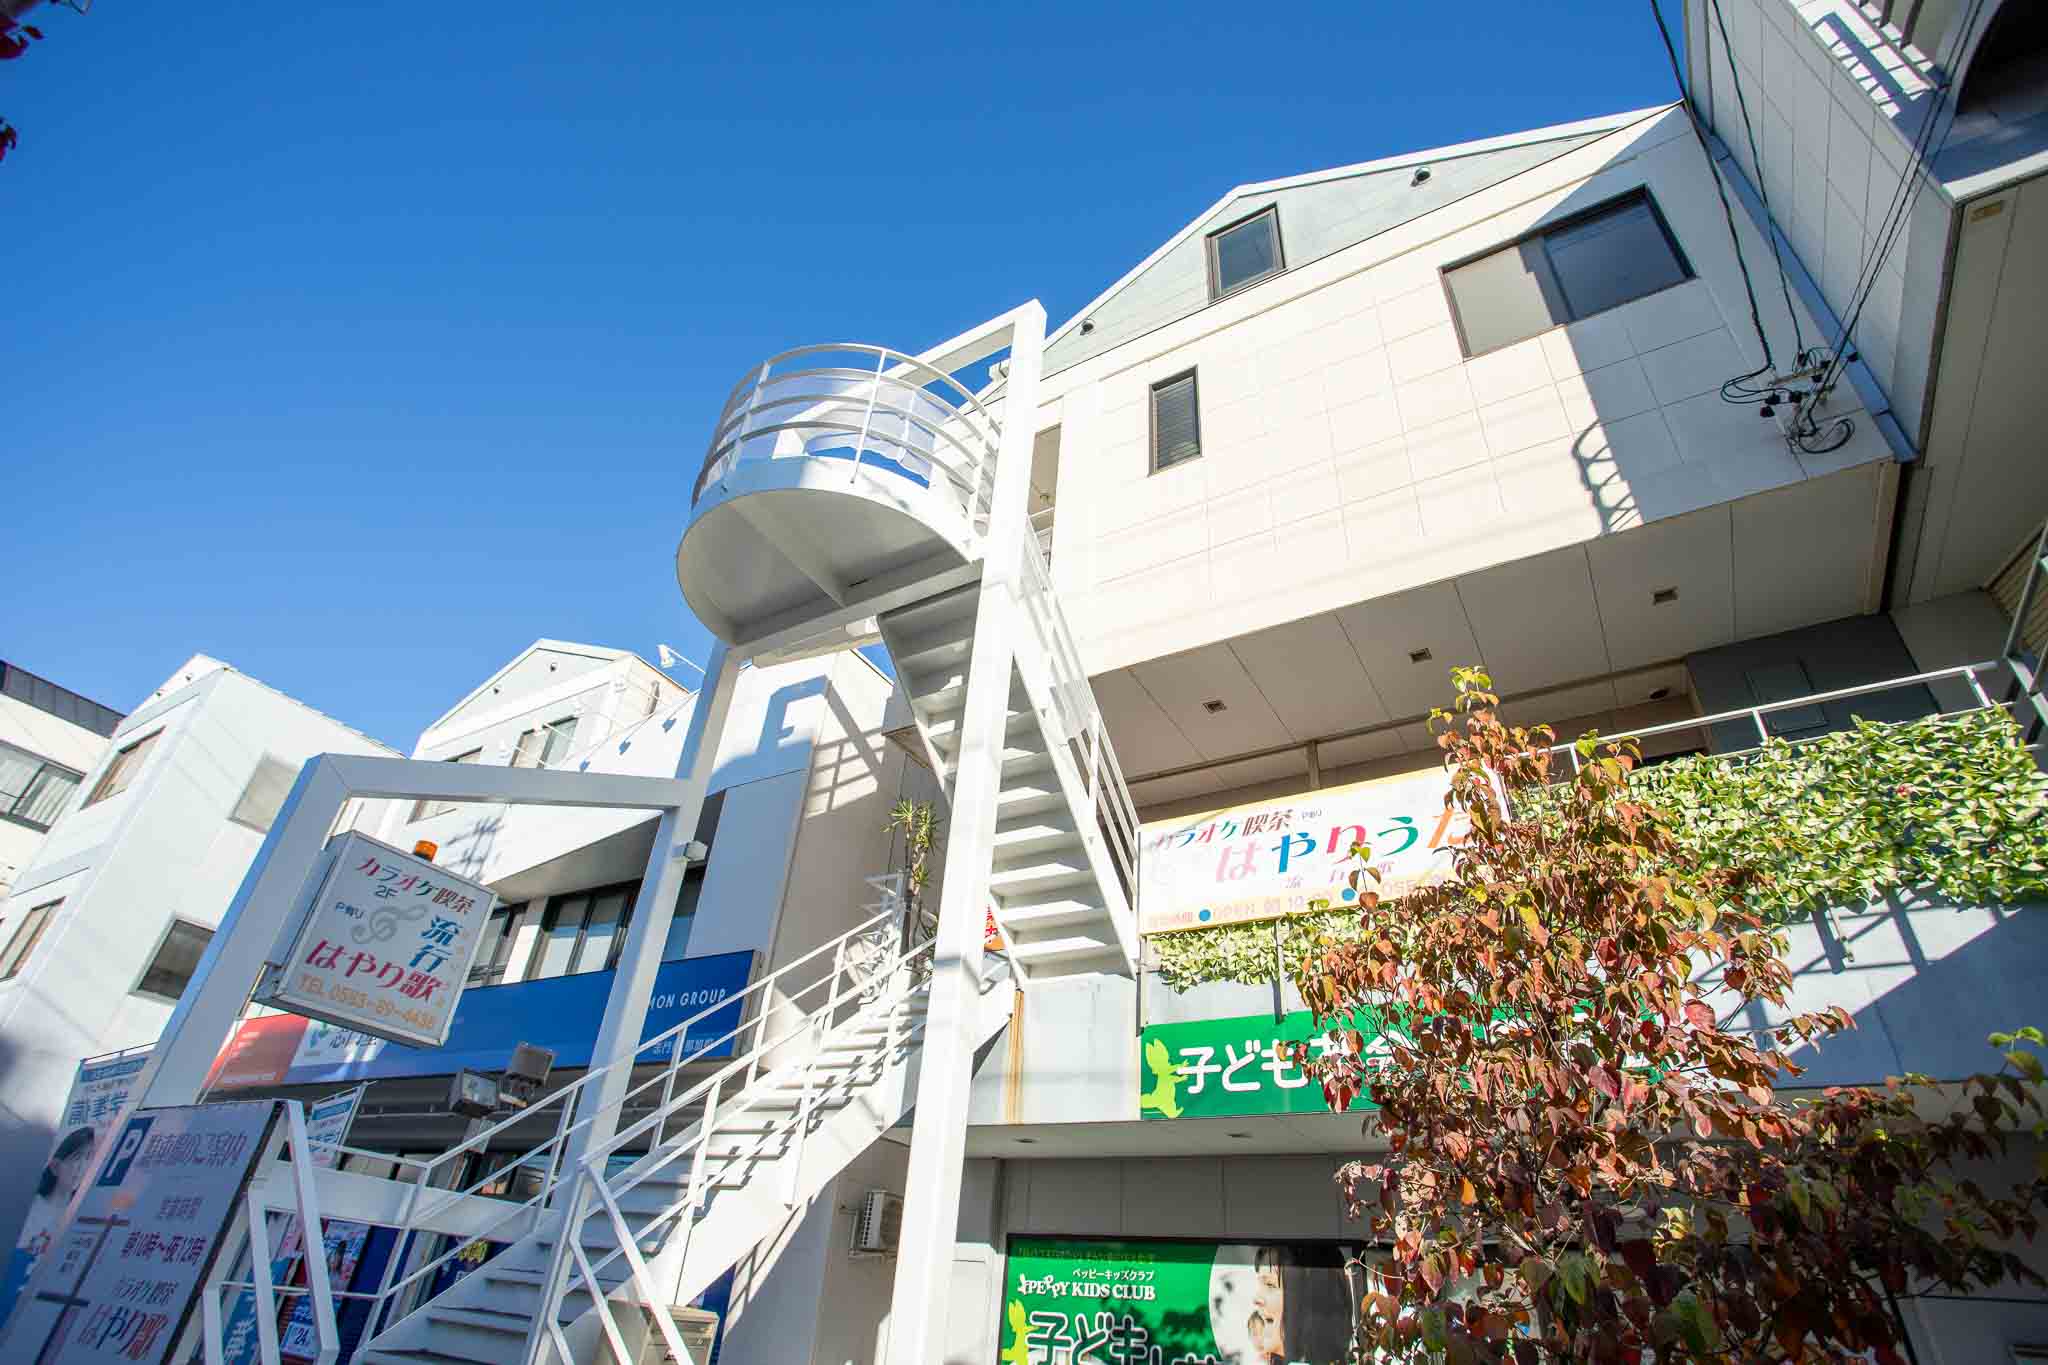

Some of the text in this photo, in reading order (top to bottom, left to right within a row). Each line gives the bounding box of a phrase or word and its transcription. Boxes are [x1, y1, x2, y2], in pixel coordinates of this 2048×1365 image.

[357, 857, 477, 915] カラオケ喫茶
[374, 884, 399, 900] 2F
[304, 939, 448, 1001] はやり歌
[679, 988, 727, 1007] GROUP
[1072, 1268, 1155, 1282] ペッピーキッズクラブ
[1071, 1281, 1111, 1299] KIDS
[1112, 1284, 1156, 1302] CLUB
